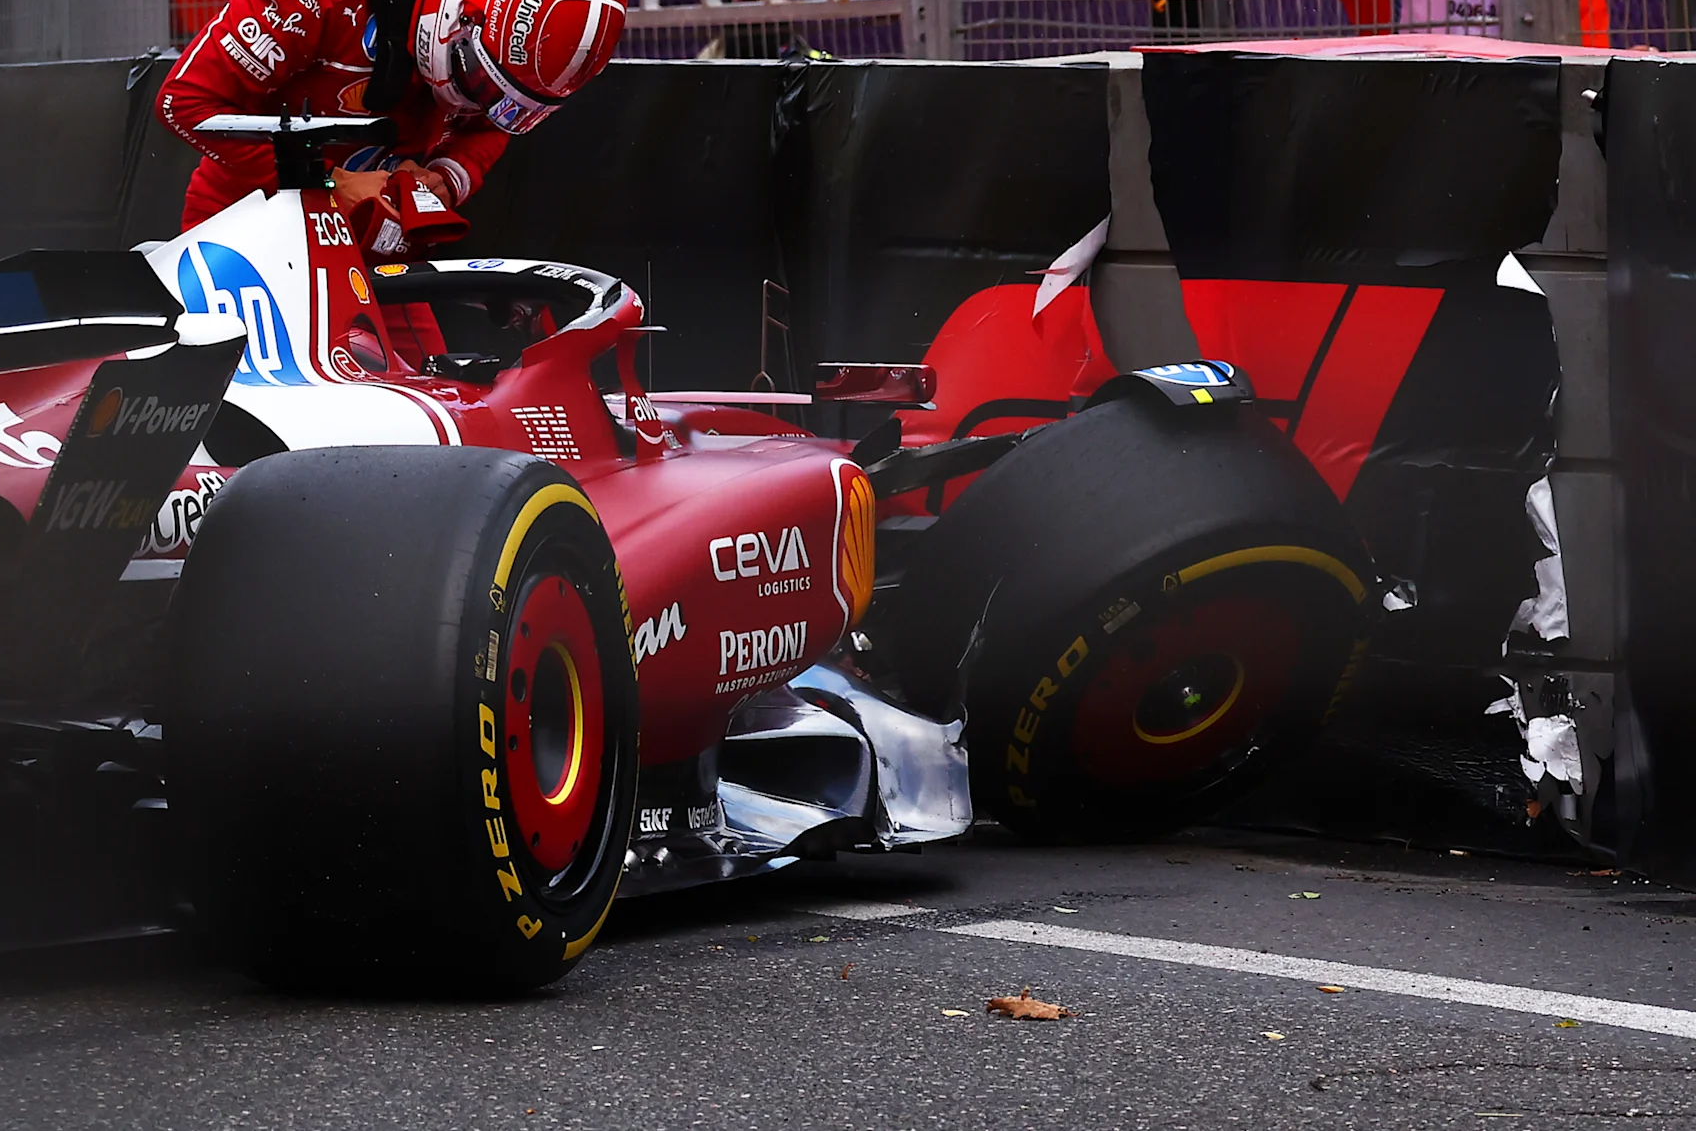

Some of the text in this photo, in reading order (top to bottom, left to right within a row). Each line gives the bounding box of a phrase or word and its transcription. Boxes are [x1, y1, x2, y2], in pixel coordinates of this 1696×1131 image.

[219, 32, 272, 82] PIRELLI
[112, 396, 210, 436] V-Power
[510, 406, 582, 460] IBM
[758, 576, 811, 597] LOGISTICS
[718, 621, 807, 676] PERONI
[715, 665, 798, 695] NASTRO AZZURRO
[1007, 635, 1090, 776] ZERO
[478, 702, 524, 903] ZERO
[639, 807, 673, 832] SKF
